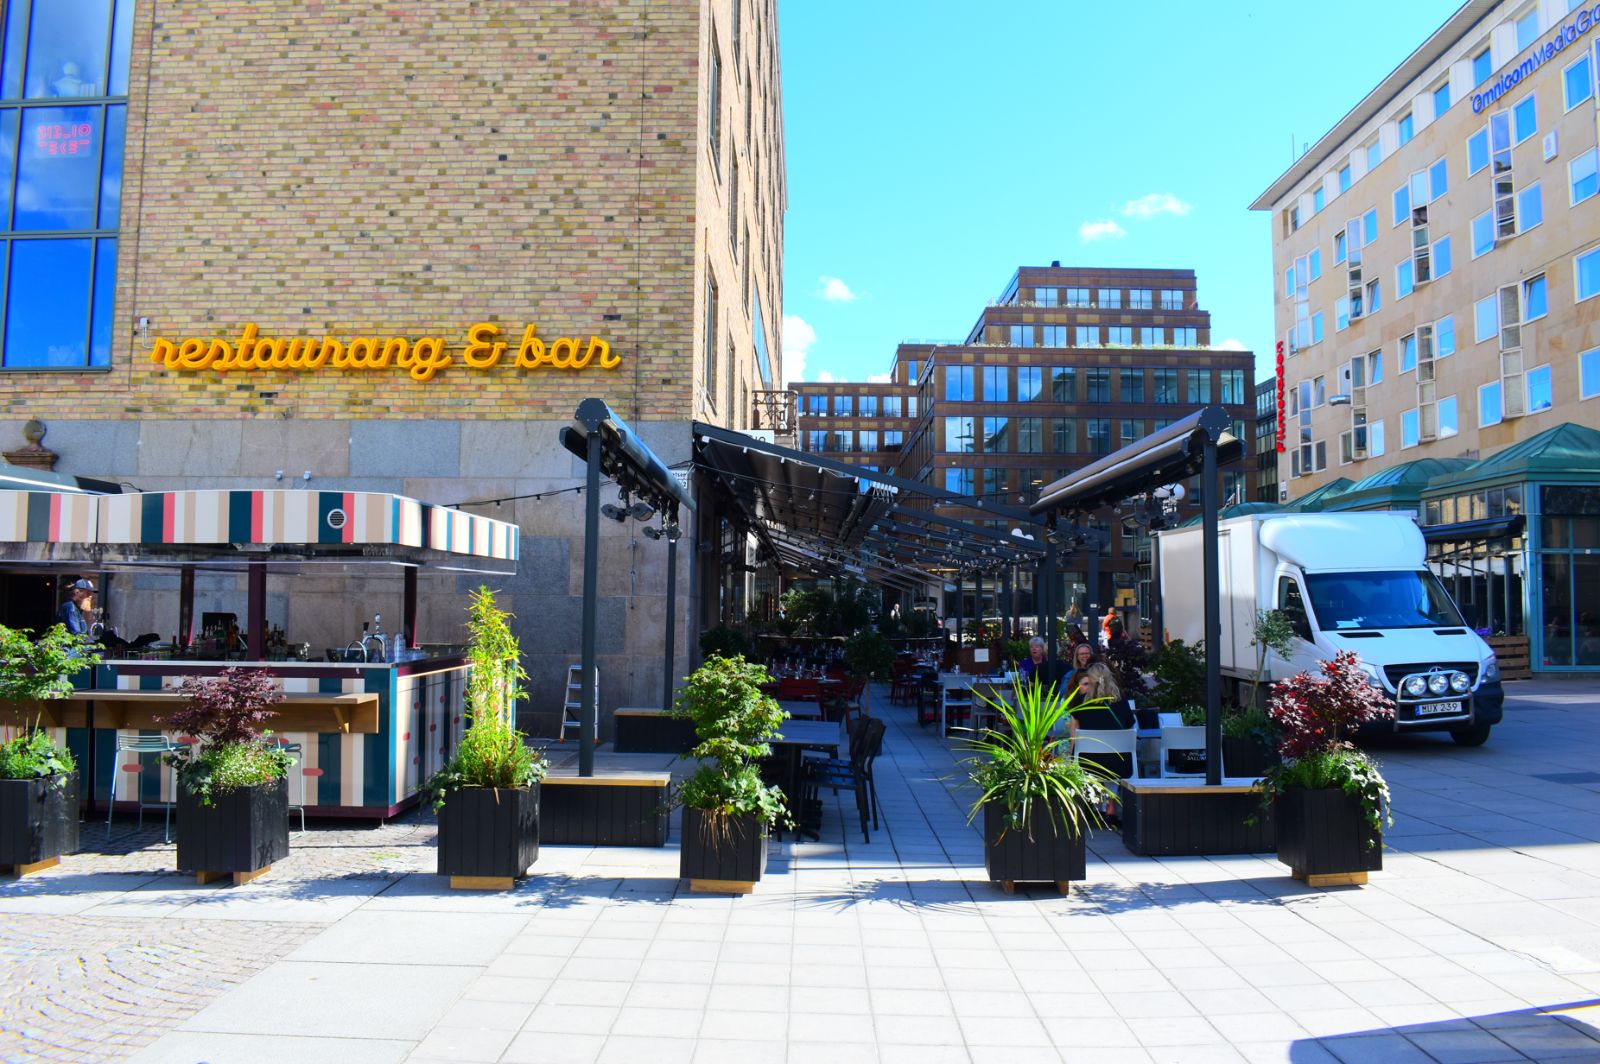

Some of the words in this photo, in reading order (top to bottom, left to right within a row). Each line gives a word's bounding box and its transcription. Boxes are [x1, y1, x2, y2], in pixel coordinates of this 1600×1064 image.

[151, 323, 453, 382] restaurang
[463, 322, 507, 370] &
[515, 323, 621, 370] bar
[1440, 702, 1458, 712] 239
